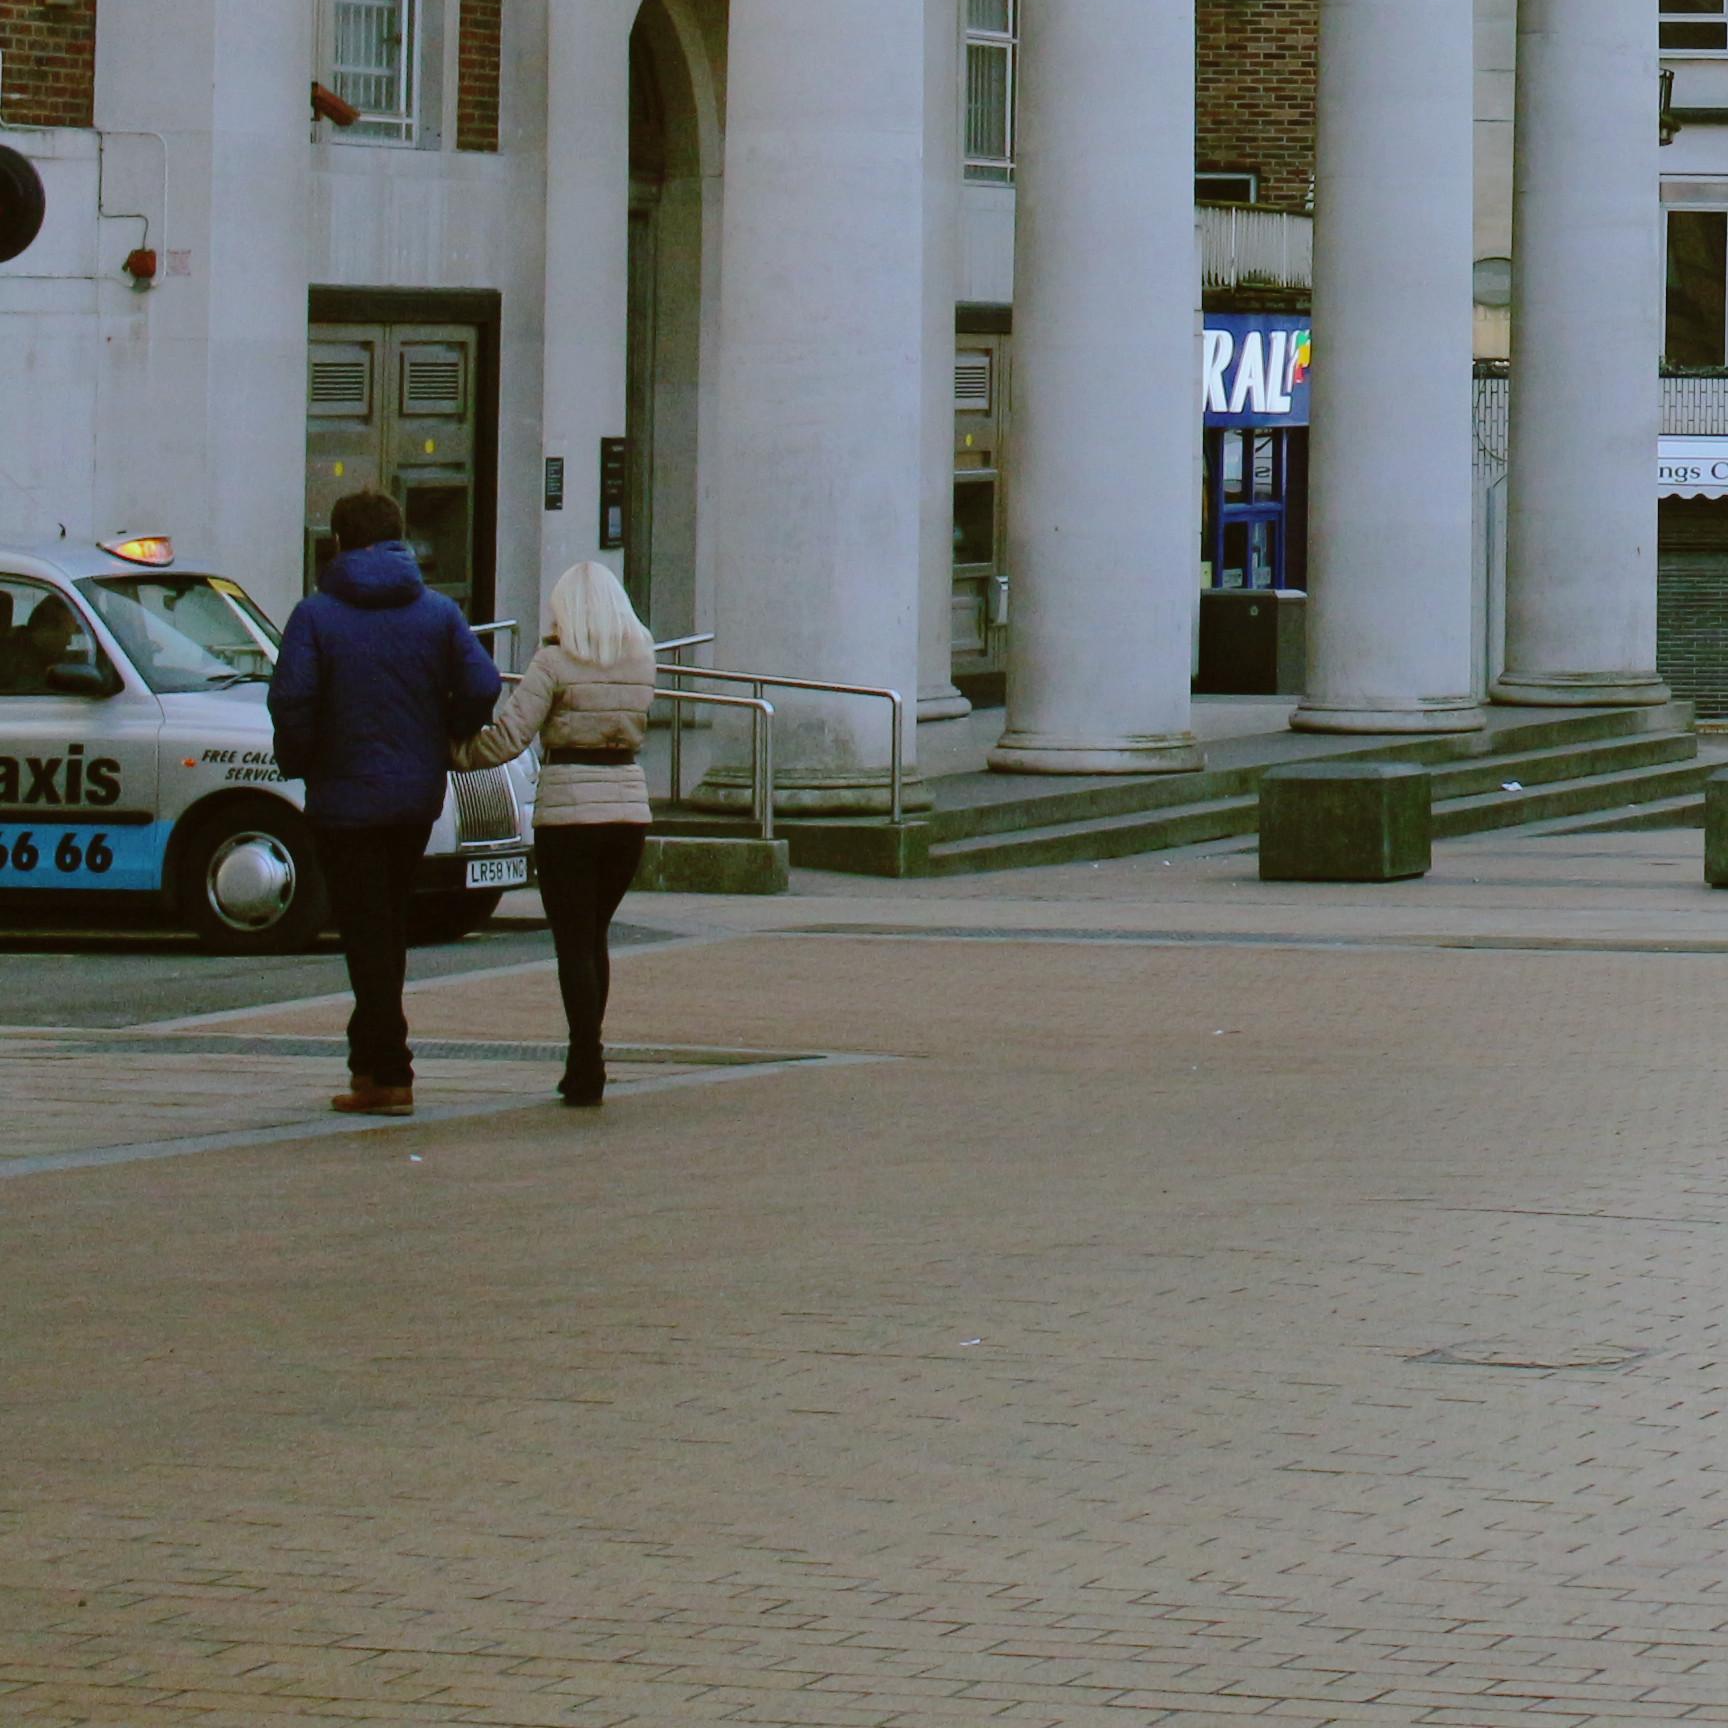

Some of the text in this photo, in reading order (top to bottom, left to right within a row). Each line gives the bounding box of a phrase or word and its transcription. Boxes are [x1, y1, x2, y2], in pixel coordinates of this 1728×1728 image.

[1658, 463, 1702, 483] ngs
[201, 749, 238, 764] FREE
[54, 832, 115, 875] 66
[471, 861, 503, 884] LR58
